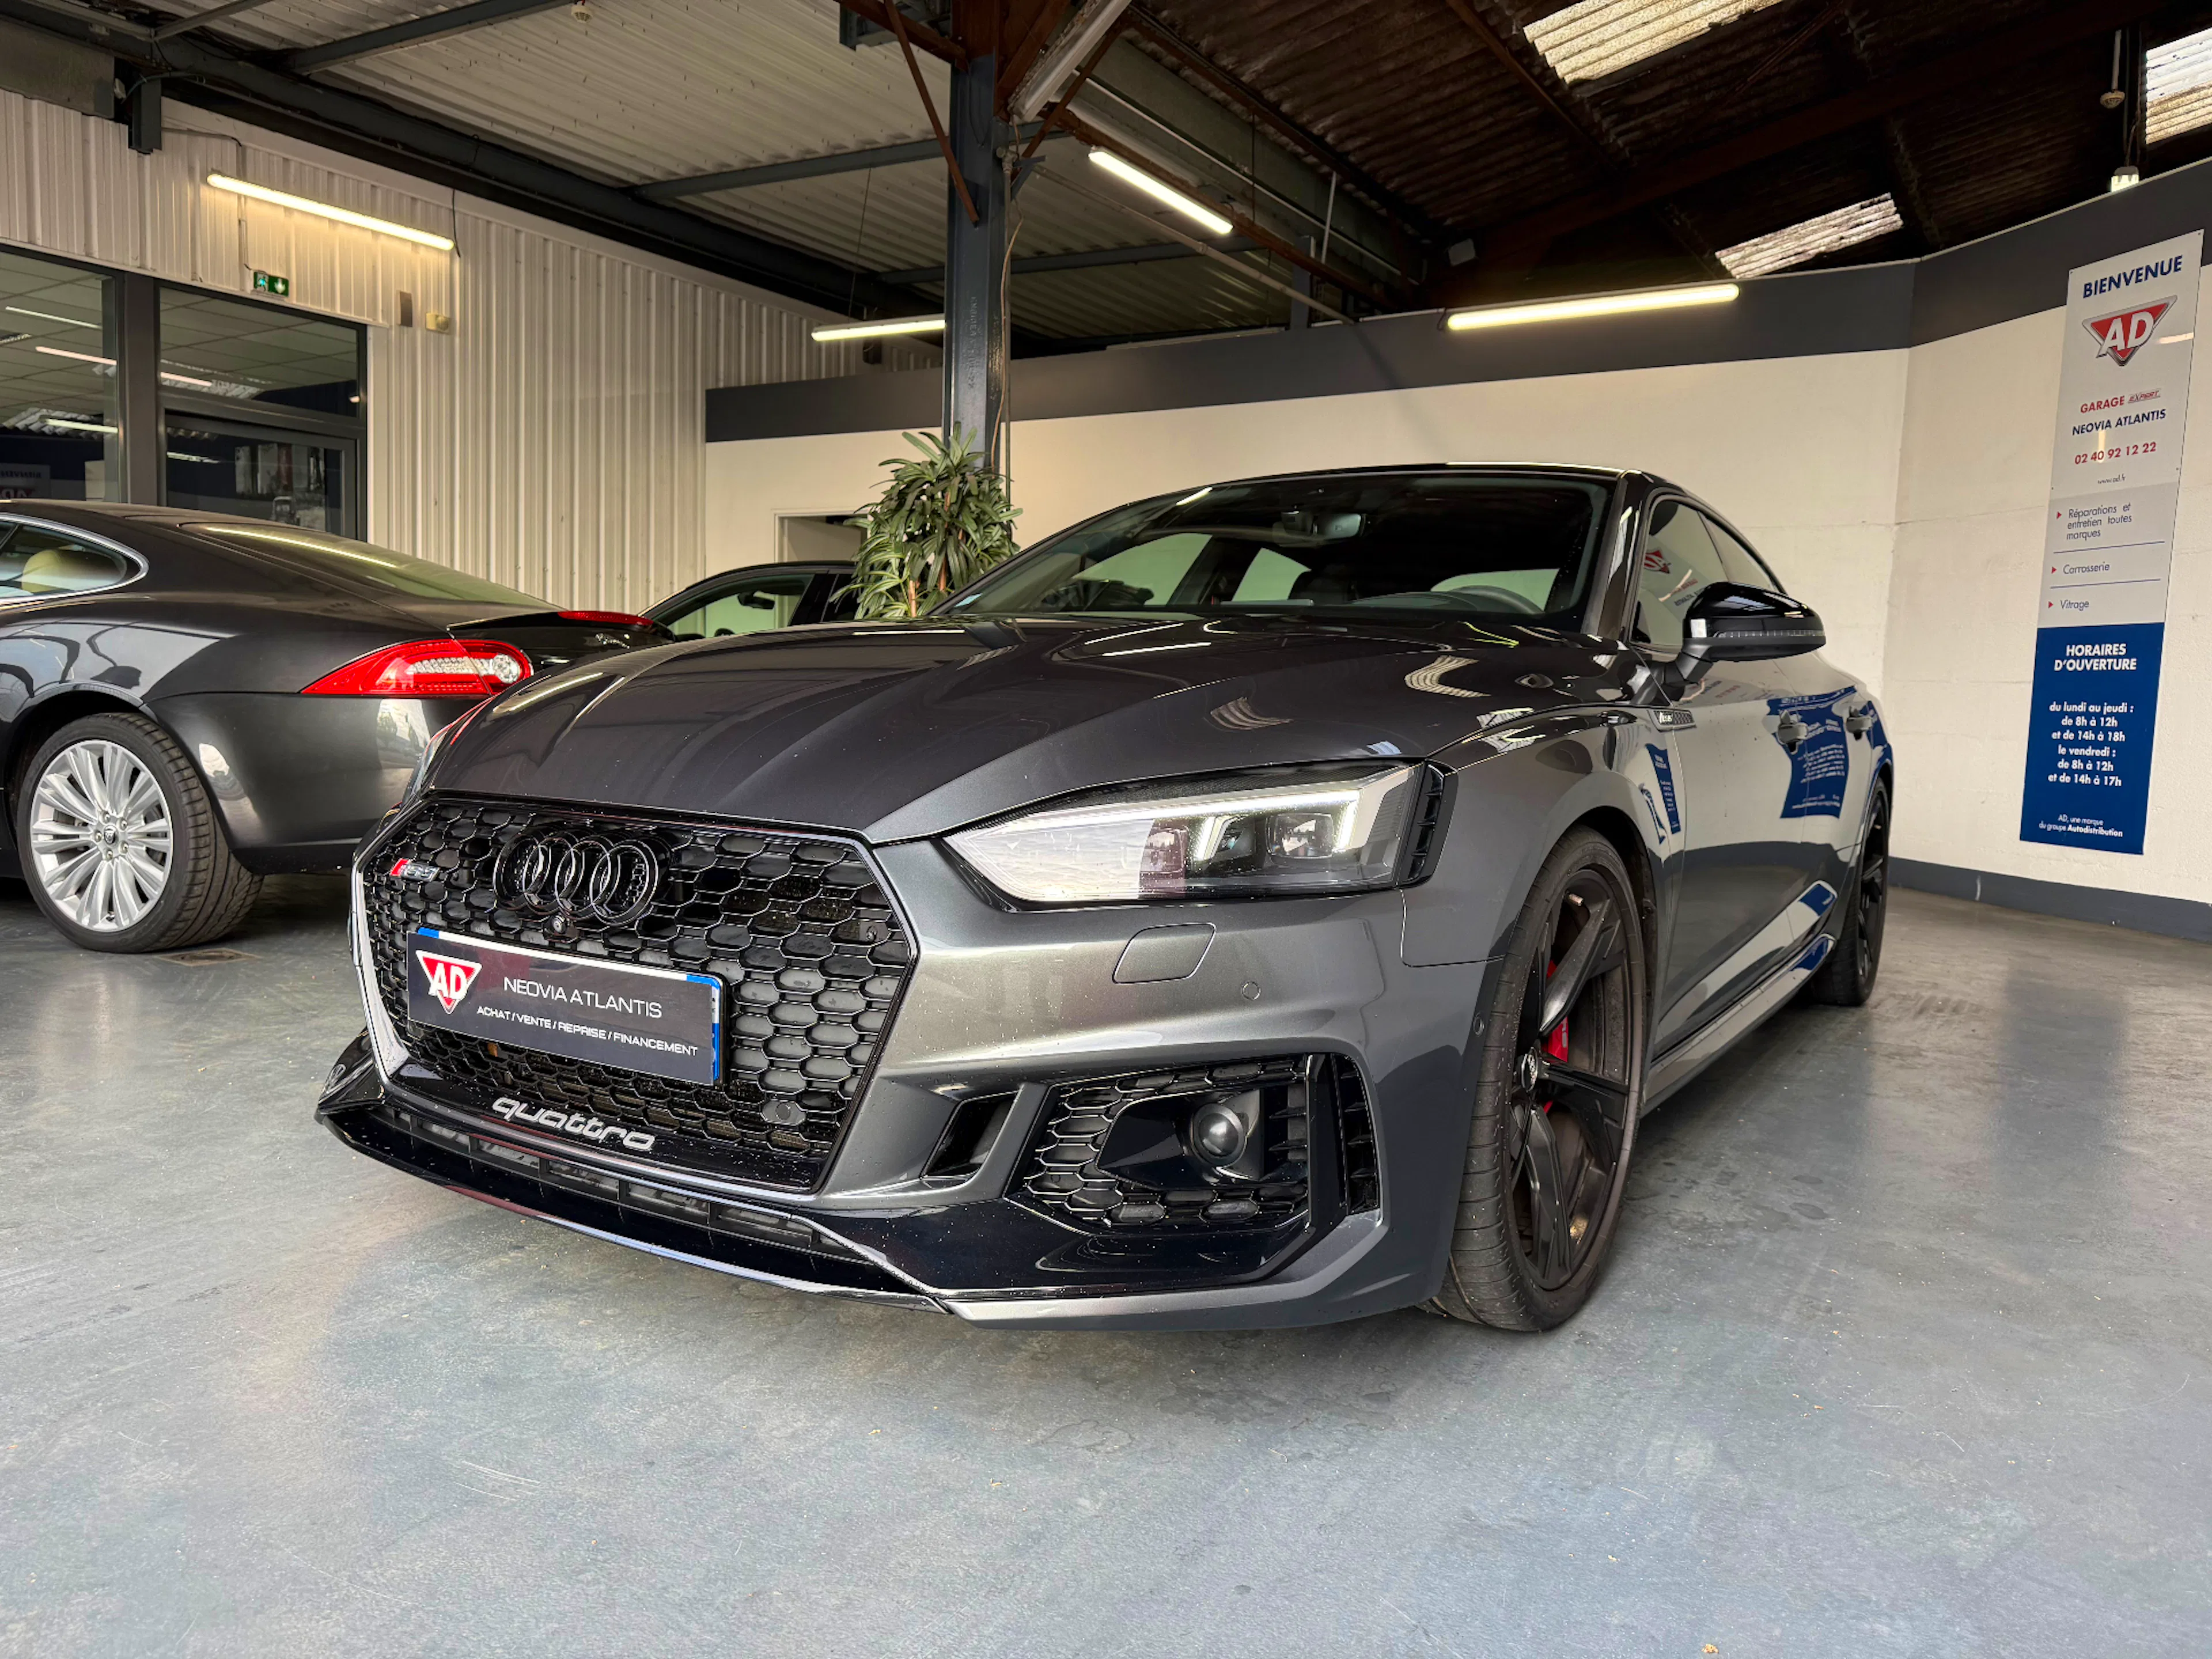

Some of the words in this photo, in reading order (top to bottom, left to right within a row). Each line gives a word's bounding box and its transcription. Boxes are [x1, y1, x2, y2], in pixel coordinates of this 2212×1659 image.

[2083, 255, 2183, 298] BIENVENUE
[2097, 310, 2154, 357] AD
[2080, 396, 2124, 413] GARAGE
[2072, 419, 2112, 435] NEOVIA
[2115, 409, 2166, 427] ATLANTIS
[2074, 453, 2088, 464] 02
[2091, 450, 2104, 461] 40
[2108, 448, 2121, 459] 92
[2126, 444, 2138, 456] 12
[2142, 441, 2157, 453] 22
[2069, 505, 2117, 520] Réparations
[2123, 503, 2131, 512] et
[2067, 517, 2102, 529] entretien
[2108, 516, 2132, 525] toutes
[2066, 529, 2101, 541] marques
[2063, 561, 2110, 574] Carrosserie
[2060, 600, 2089, 611] Vitrage
[2066, 643, 2127, 656] HORAIRES
[2054, 658, 2137, 671] D'OUVERTURE
[2049, 701, 2061, 712] du
[2063, 701, 2087, 713] lundi
[2088, 704, 2101, 712] au
[2103, 702, 2128, 715] jeudi
[2061, 715, 2073, 726] de
[2075, 716, 2087, 726] 8h
[2089, 716, 2097, 727] à
[2100, 716, 2118, 728] 12h
[2051, 731, 2061, 739] et
[2063, 729, 2074, 740] de
[2078, 730, 2095, 741] 14h
[2097, 731, 2104, 741] à
[2108, 731, 2126, 742] 18h
[2058, 744, 2066, 755] le
[2069, 745, 2111, 757] vendredi
[2057, 758, 2070, 770] de
[2071, 759, 2084, 770] 8h
[2086, 760, 2093, 770] à
[2096, 760, 2114, 772] 12h
[2048, 773, 2058, 782] et
[2059, 772, 2071, 783] de
[2074, 773, 2091, 784] 14h
[2093, 775, 2100, 785] à
[2104, 775, 2122, 787] 17h
[2058, 813, 2069, 823] AD,
[2081, 818, 2104, 826] marque
[2039, 820, 2046, 828] du
[2047, 823, 2066, 832] groupe
[2067, 824, 2123, 837] Autodistribution
[429, 963, 468, 1001] AD
[504, 976, 567, 1002] NEOVIA
[570, 989, 662, 1018] ATLANTIS
[476, 1006, 511, 1020] ACHAT
[516, 1013, 552, 1029] VENTE
[558, 1021, 607, 1040] REPRISE
[613, 1032, 698, 1056] FINANCEMENT
[492, 1096, 656, 1152] quattro
